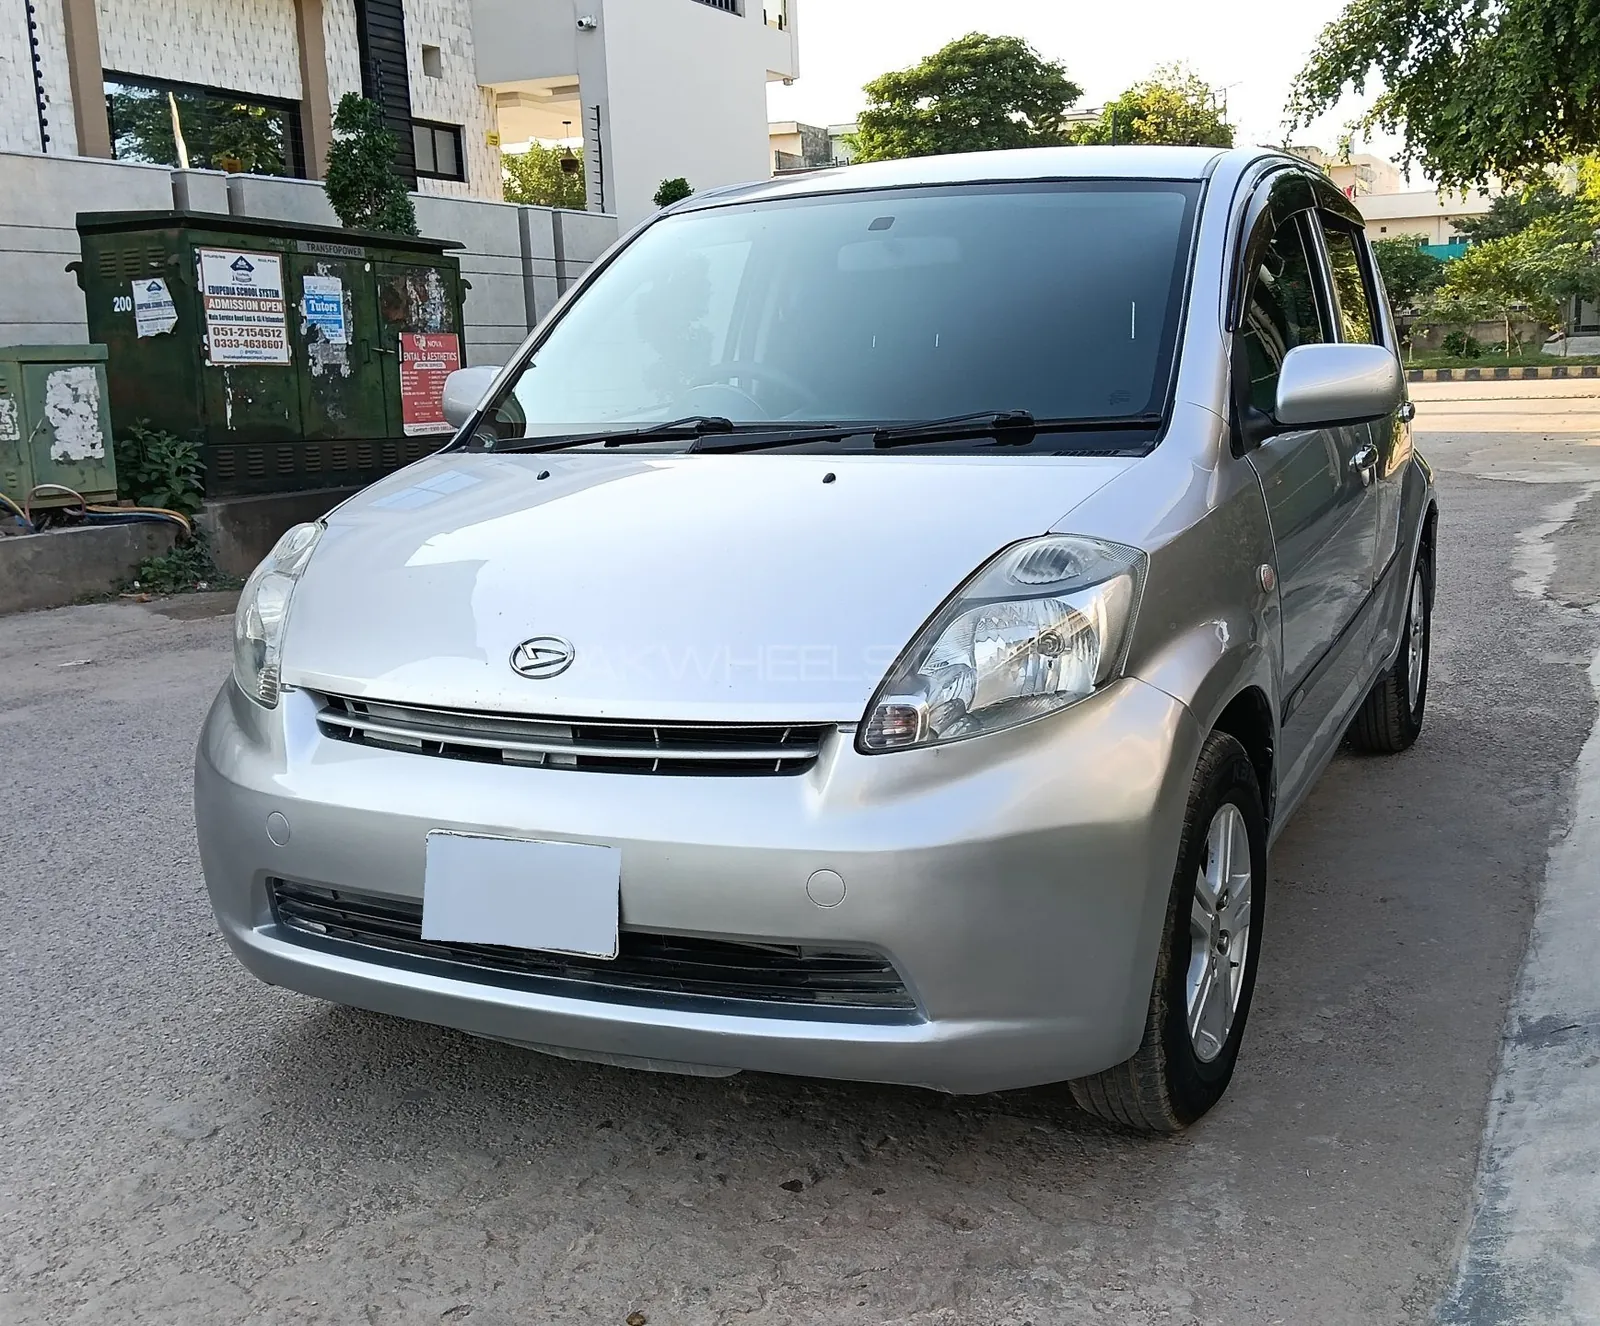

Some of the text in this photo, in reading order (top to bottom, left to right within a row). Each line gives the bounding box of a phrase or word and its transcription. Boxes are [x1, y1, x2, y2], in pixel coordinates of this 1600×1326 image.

[306, 242, 362, 256] TRANSFOPOWER
[208, 285, 280, 298] EDUPEDIA SCHOOL SYSTEM
[113, 296, 132, 312] 200
[208, 298, 283, 312] ADMISSION OPEN
[309, 300, 338, 312] Tutors
[212, 327, 282, 338] 051-2154512
[214, 339, 284, 350] 0333-4638607
[427, 340, 443, 348] NOVA
[403, 352, 421, 361] ENTAL
[427, 352, 457, 361] AESTHETICS
